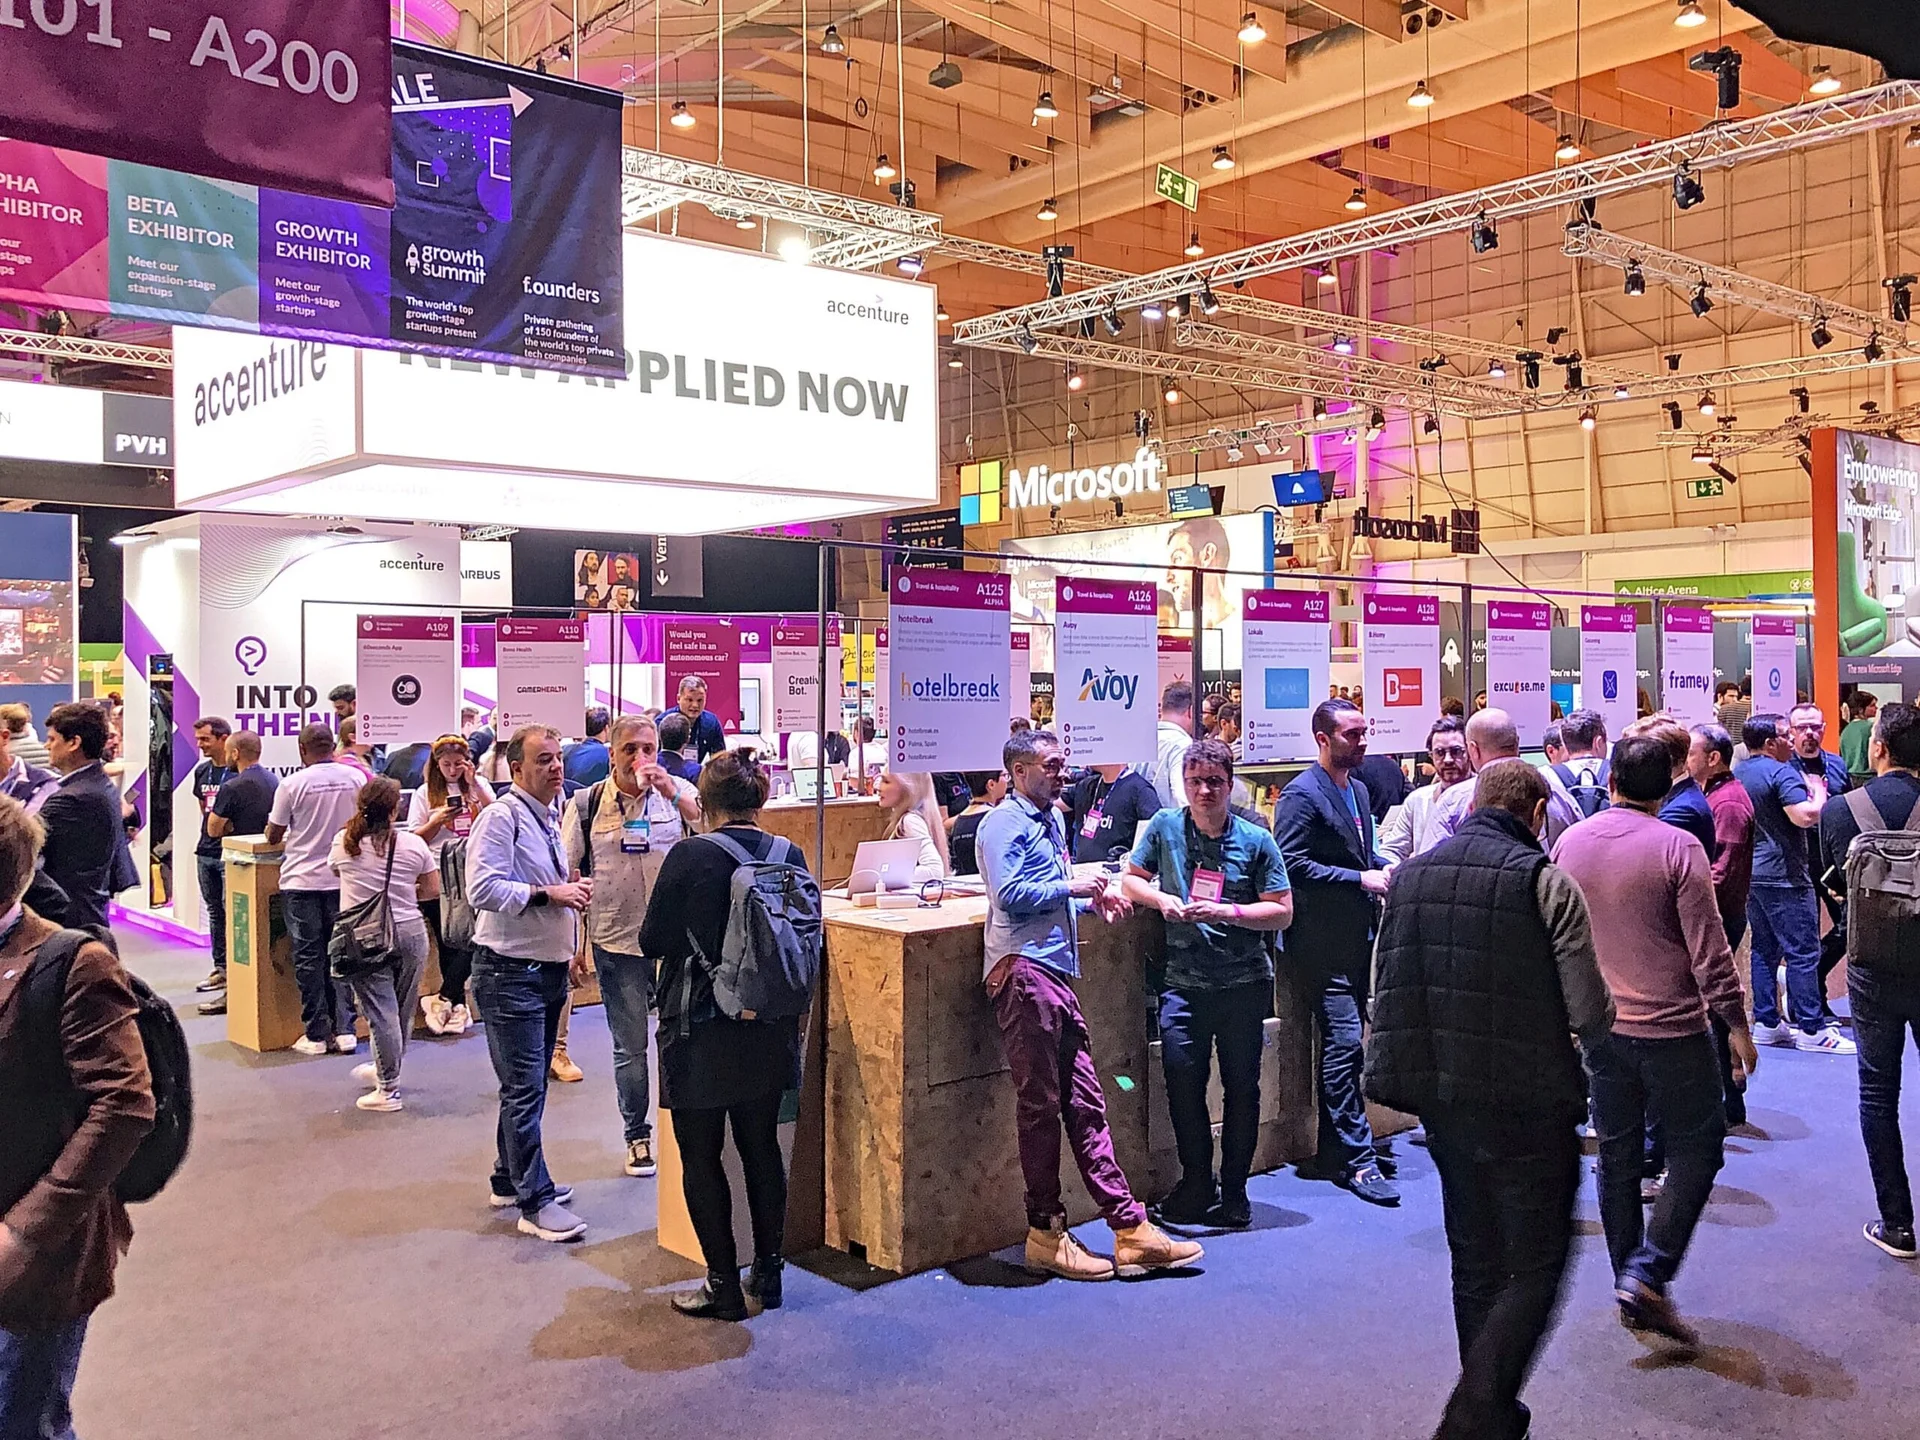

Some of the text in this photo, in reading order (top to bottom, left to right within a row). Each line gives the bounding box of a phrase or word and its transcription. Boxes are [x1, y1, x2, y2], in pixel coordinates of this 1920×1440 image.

[190, 15, 358, 103] A200
[127, 195, 178, 218] BETA
[128, 218, 235, 250] EXHIBITOR
[275, 220, 358, 248] GROWTH
[128, 255, 179, 271] Meet our
[276, 241, 371, 270] EXHIBITOR
[421, 245, 484, 267] growth
[128, 270, 216, 291] expansion-stage
[422, 262, 486, 285] summit
[127, 283, 173, 298] startups
[275, 277, 321, 292] Meet our
[523, 276, 600, 303] f.ounders
[275, 292, 341, 308] growth-stage
[405, 295, 474, 315] The world's top
[275, 303, 316, 317] startups
[405, 310, 465, 326] growth-stage
[827, 300, 909, 325] accenture
[405, 321, 477, 338] startups present
[524, 313, 594, 334] Private gathering
[524, 326, 599, 344] of 150 founders of
[524, 337, 615, 357] the world's top private
[524, 349, 587, 365] tech companies
[194, 340, 328, 426] accenture
[798, 371, 909, 422] NOW
[116, 433, 167, 455] PVH
[1009, 446, 1161, 509] Microsoft
[1844, 454, 1918, 495] Empowering
[1844, 499, 1903, 525] Microsoft Edge
[379, 558, 445, 571] accenture
[915, 582, 930, 590] Travel
[935, 584, 959, 592] hospitality
[977, 583, 1004, 596] A125
[1128, 590, 1151, 602] A126
[1634, 584, 1698, 595] Altice Arena
[1304, 600, 1324, 610] A127
[1417, 604, 1435, 614] A128
[898, 615, 933, 624] hotelbreak
[1531, 611, 1547, 620] A129
[1620, 614, 1633, 623] A130
[426, 623, 448, 631] A109
[559, 626, 579, 634] A110
[669, 630, 706, 640] Would you
[669, 642, 683, 650] feel
[740, 631, 760, 645] re
[714, 653, 729, 662] car?
[1472, 652, 1486, 663] for
[901, 672, 999, 697] hotelbreak
[1078, 667, 1138, 710] Avoy
[1386, 673, 1400, 702] B
[1494, 681, 1545, 693] excurse.me
[1669, 670, 1709, 694] framey
[236, 685, 318, 709] INTO
[789, 686, 807, 696] Bot.
[235, 712, 301, 737] THE
